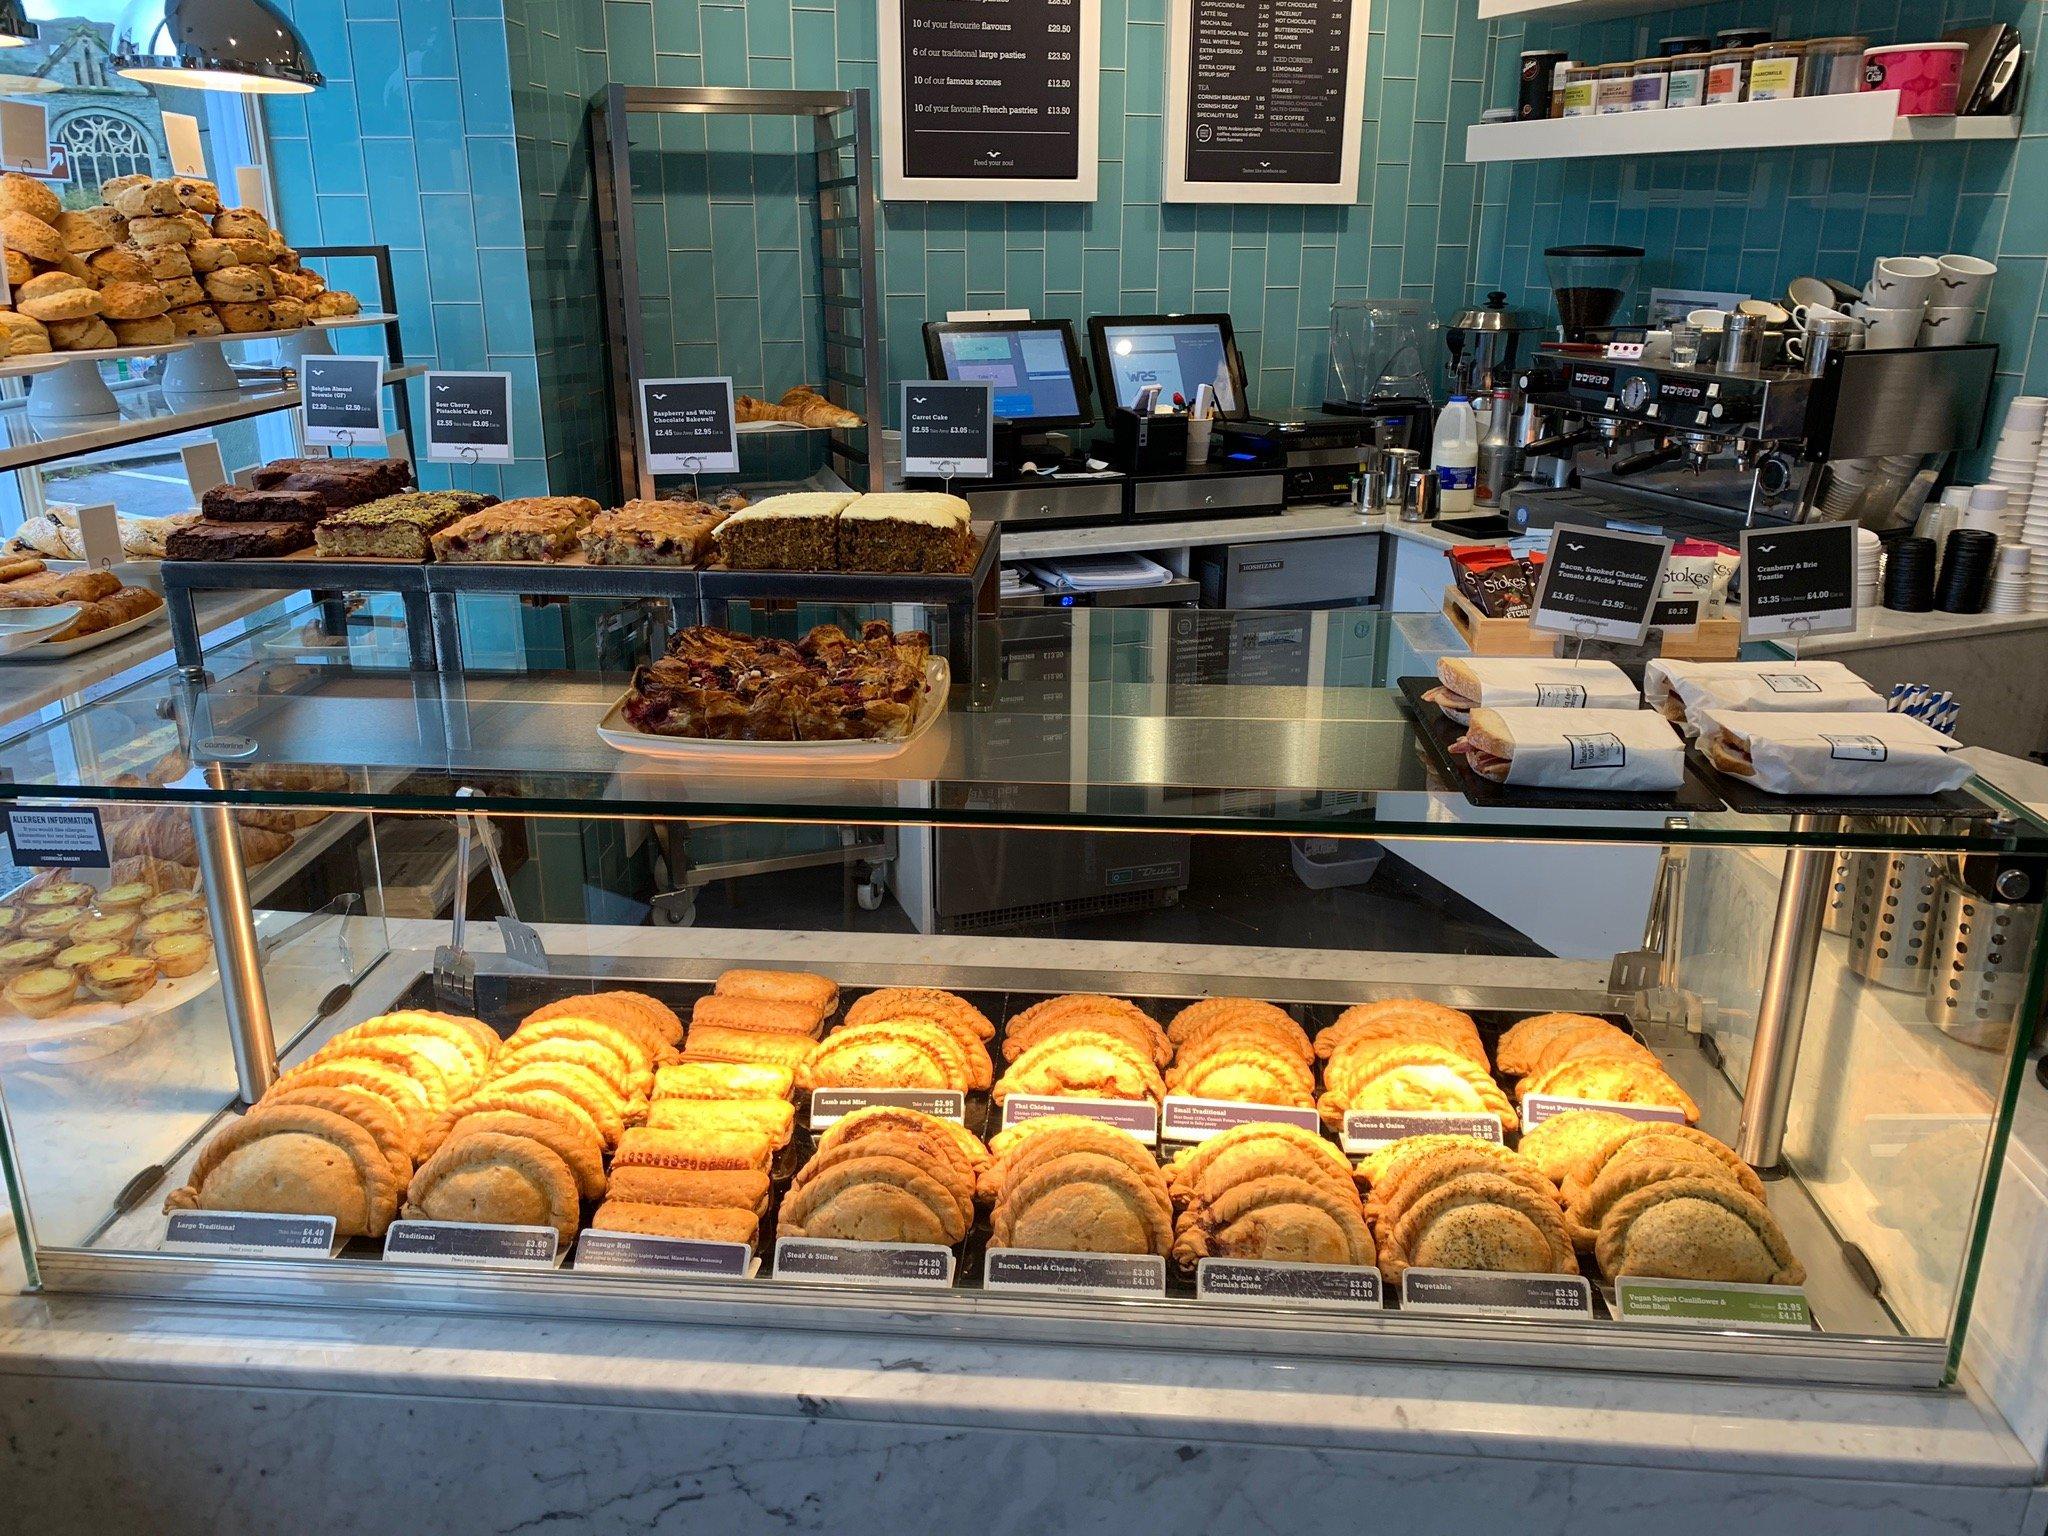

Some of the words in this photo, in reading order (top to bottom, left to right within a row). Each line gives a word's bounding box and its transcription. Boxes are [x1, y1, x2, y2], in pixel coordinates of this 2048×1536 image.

[913, 20, 921, 28] 10
[923, 20, 931, 28] of
[950, 22, 980, 30] favourite
[982, 22, 1011, 31] flavours
[1048, 25, 1070, 33] £29.50
[913, 48, 918, 56] 6
[942, 49, 977, 58] traditional
[979, 50, 998, 59] large
[1000, 50, 1026, 59] pasties
[914, 76, 922, 84] 10
[924, 76, 931, 84] of
[946, 77, 973, 85] famous
[975, 78, 1001, 86] scones
[1866, 72, 1883, 82] Chai
[933, 105, 949, 113] your
[951, 105, 981, 113] favourite
[983, 105, 1007, 114] French
[1009, 106, 1038, 115] pastries
[1560, 562, 1584, 572] Bacon,
[1585, 566, 1615, 576] Smoked
[1616, 570, 1648, 582] Cheddar,
[1757, 563, 1794, 572] Cranberry
[1484, 575, 1527, 593] Stokes
[1559, 571, 1584, 580] Tomato
[1593, 576, 1616, 585] Pickle
[1617, 579, 1644, 588] Toastie
[1552, 591, 1575, 601] £3.45
[1602, 600, 1625, 609] £3.95
[1758, 596, 1779, 604] £3.35
[1807, 591, 1829, 599] £4.00
[1504, 609, 1533, 619] ETCHU
[13, 816, 46, 824] ALLERGEN
[48, 816, 93, 824] INFORMATION
[1192, 1108, 1226, 1116] Traditional
[177, 1221, 196, 1229] Large
[198, 1222, 235, 1231] Traditional
[302, 1228, 324, 1236] £4.40
[399, 1232, 435, 1241] Traditional
[301, 1237, 322, 1245] £4.80
[525, 1240, 547, 1248] £3.60
[587, 1240, 615, 1249] Sausage
[525, 1249, 546, 1257] £3.95
[815, 1253, 838, 1261] Stilton
[918, 1259, 940, 1267] £4.20
[998, 1262, 1021, 1271] Bacon,
[1050, 1264, 1077, 1272] Cheese
[918, 1268, 940, 1276] £4.60
[1132, 1269, 1155, 1277] £3.80
[1132, 1278, 1154, 1286] £4.10
[1211, 1273, 1229, 1281] Pork,
[1231, 1274, 1252, 1282] Apple
[1211, 1281, 1239, 1289] Cornish
[1350, 1280, 1372, 1289] £3.80
[1415, 1282, 1451, 1291] Vegetable
[1555, 1289, 1578, 1298] £3.50
[1555, 1298, 1579, 1307] £3.75
[1629, 1294, 1651, 1302] Vegan
[1653, 1295, 1677, 1304] Spiced
[1678, 1296, 1719, 1305] Cauliflower
[1653, 1303, 1670, 1311] Bhaji
[1777, 1302, 1801, 1311] £3.95
[1779, 1312, 1803, 1321] £4.15
